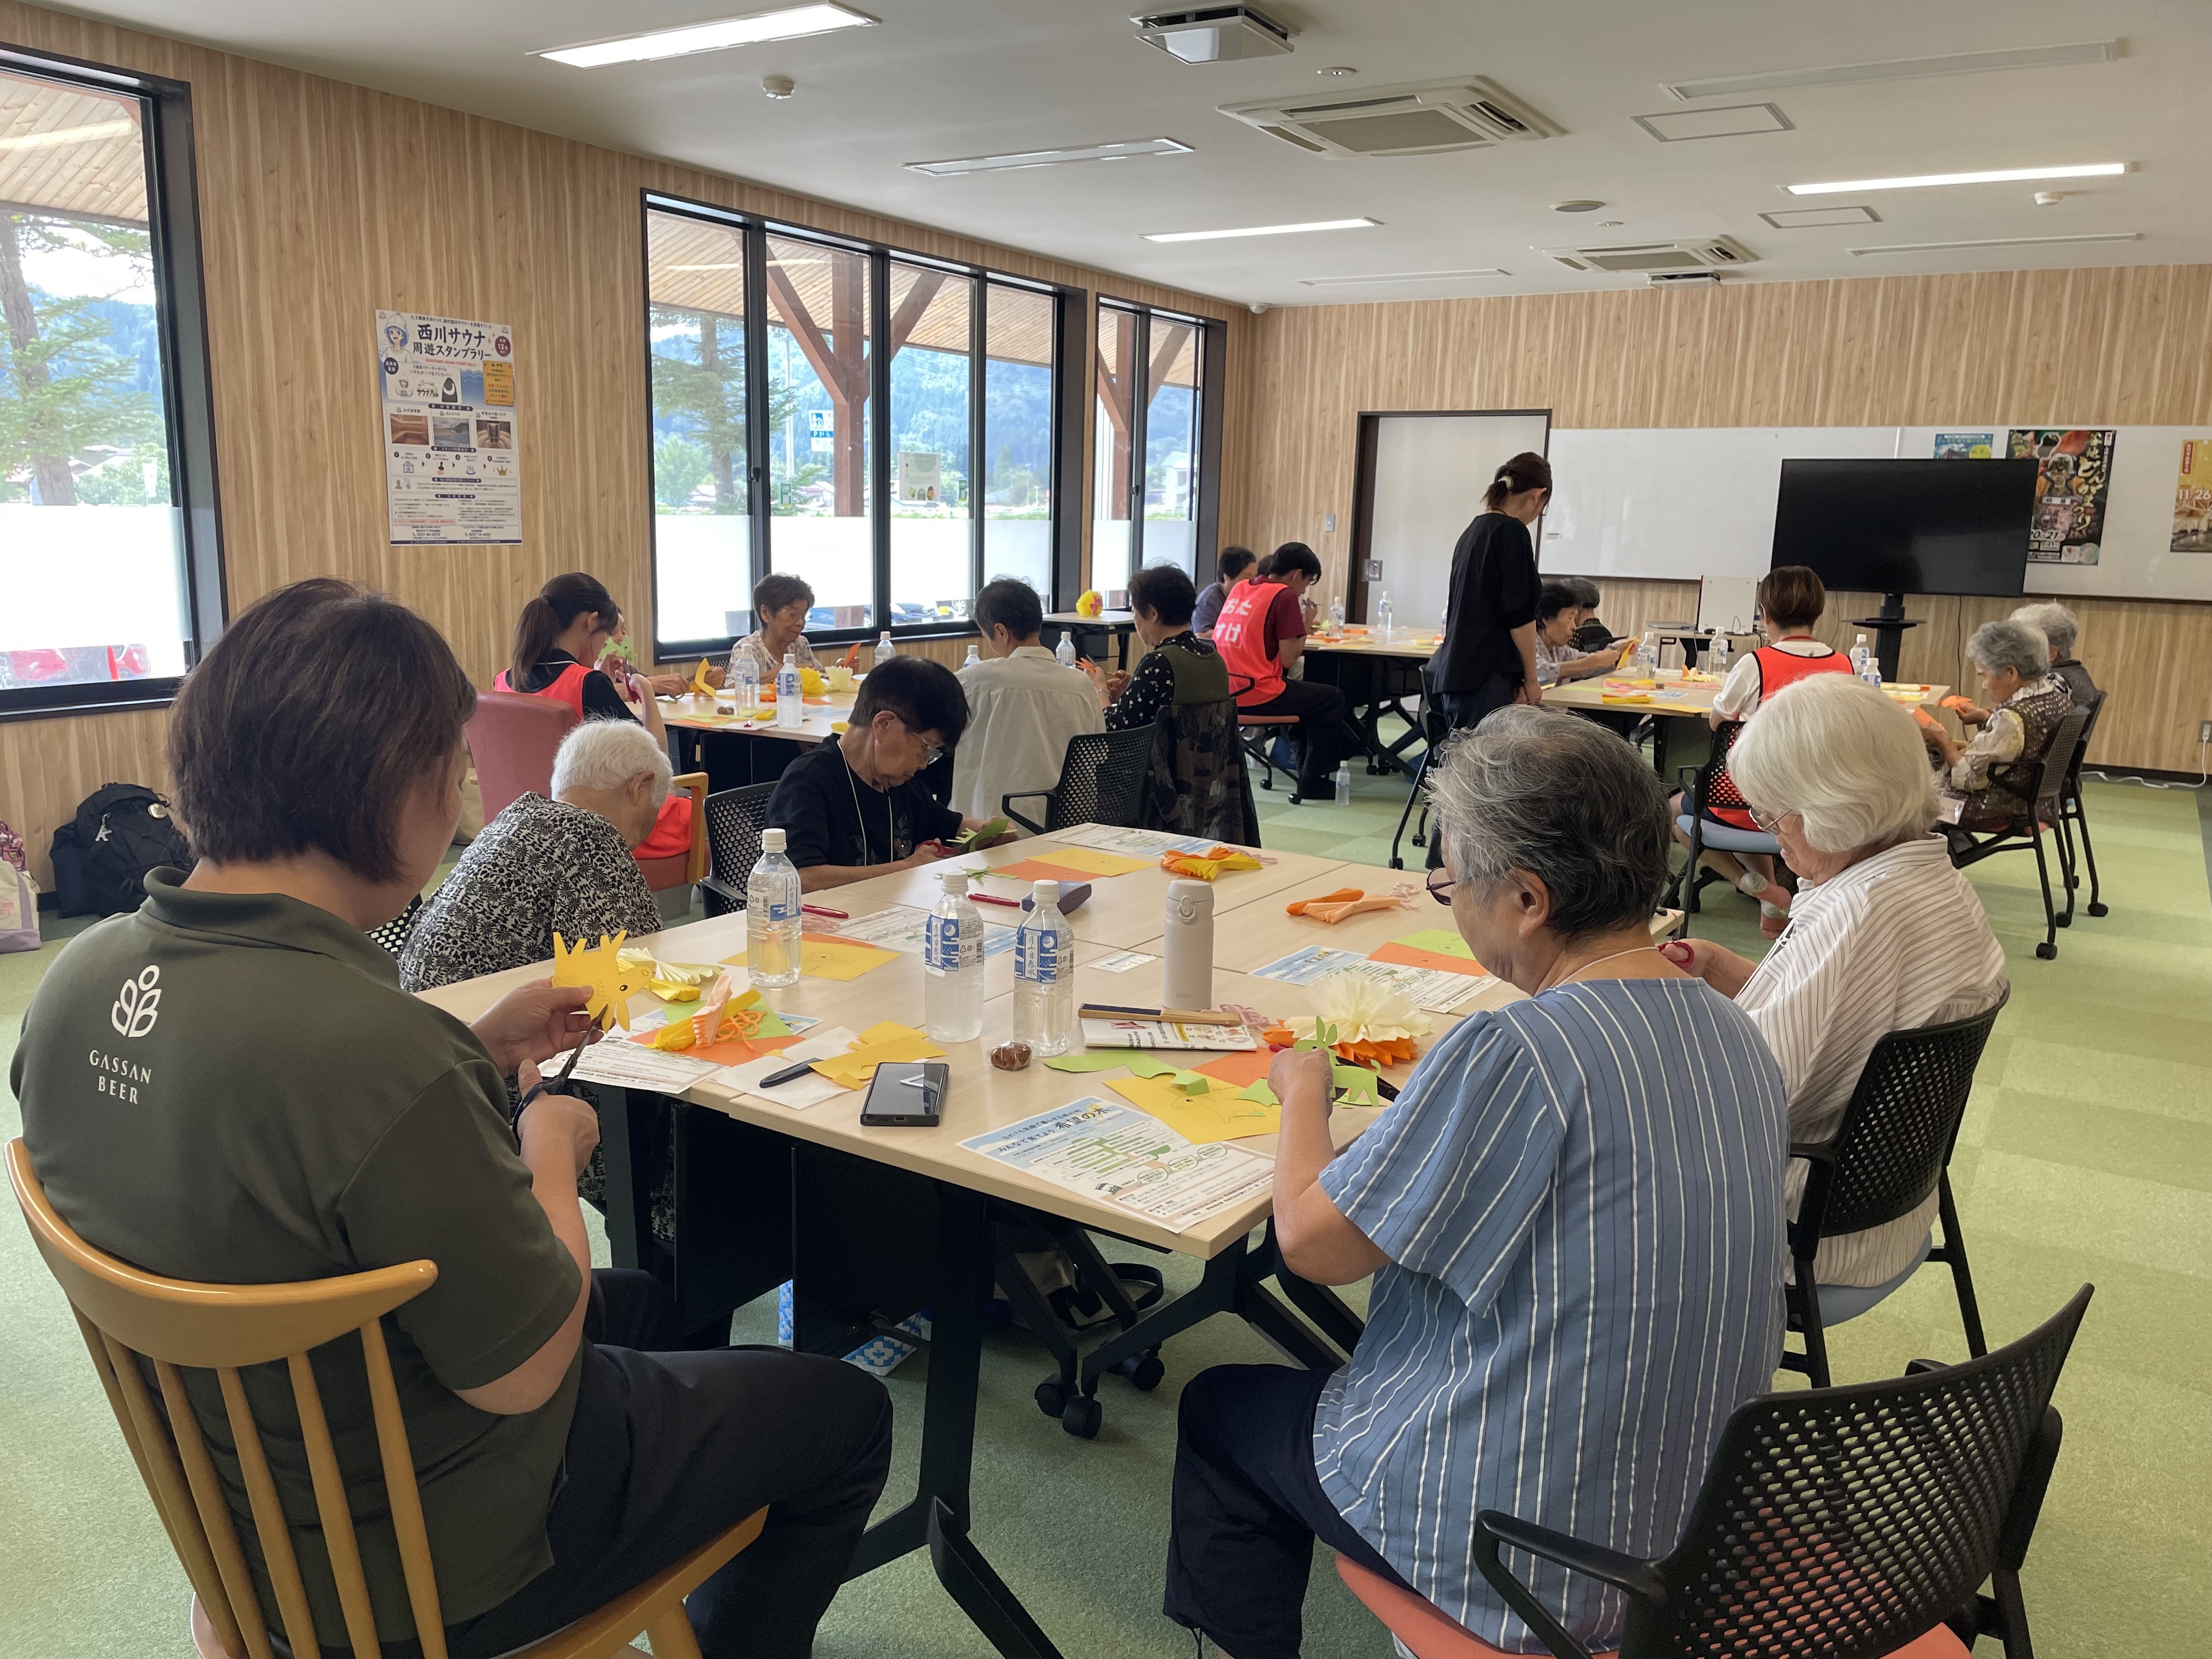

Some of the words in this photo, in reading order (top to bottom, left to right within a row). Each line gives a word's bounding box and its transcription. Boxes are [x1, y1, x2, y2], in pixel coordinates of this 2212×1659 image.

[417, 324, 486, 347] 西川サウナ
[413, 342, 491, 360] 周遊スタンプラリー
[1221, 597, 1252, 616] おた
[1215, 623, 1242, 642] すけ
[1028, 936, 1036, 977] 月山自然水
[89, 1049, 153, 1085] GASSAN
[98, 1075, 138, 1104] BEER
[998, 1130, 1056, 1153] みんなで育てよう
[1055, 1107, 1110, 1130] 希望の木
